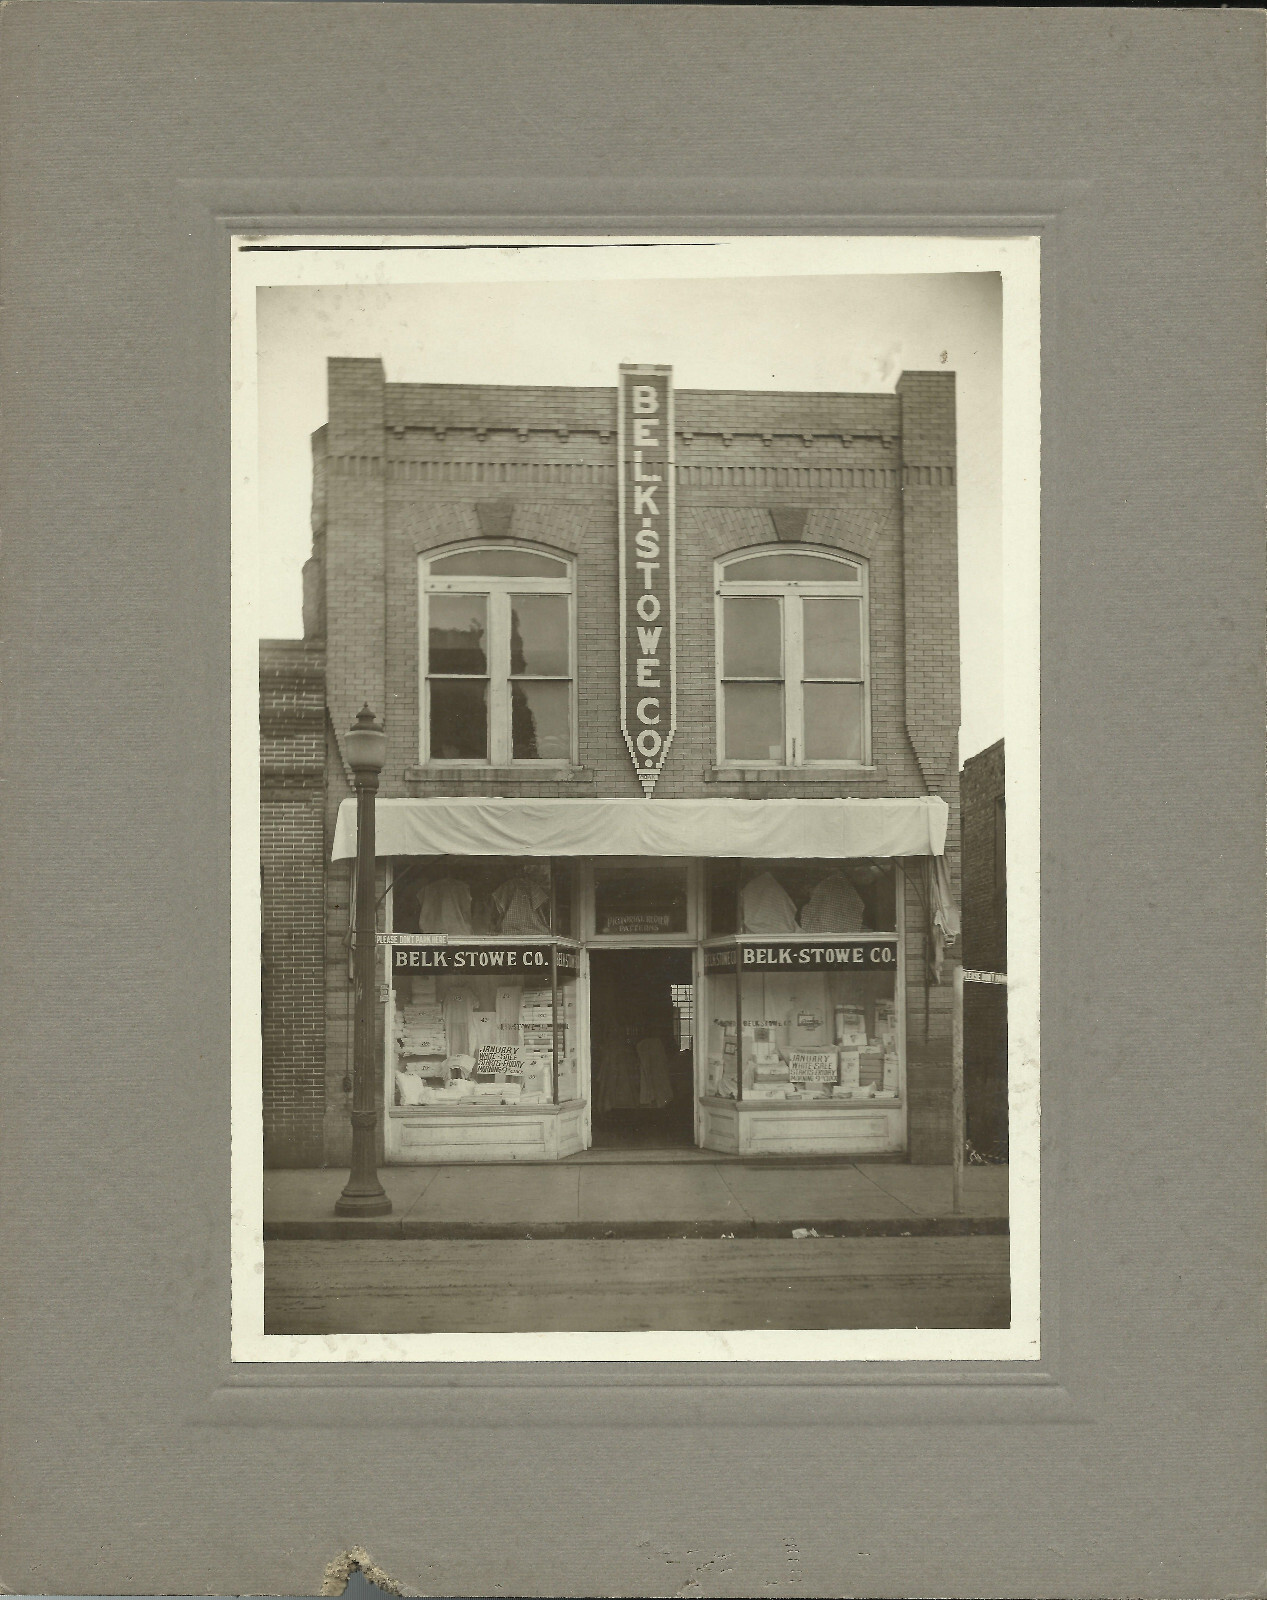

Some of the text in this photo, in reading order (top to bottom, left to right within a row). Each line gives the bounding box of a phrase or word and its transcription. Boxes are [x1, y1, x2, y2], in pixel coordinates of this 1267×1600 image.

[633, 385, 662, 688] BELK-STOWE
[636, 697, 662, 768] CO.
[376, 935, 398, 944] PLEASE
[415, 935, 431, 944] PARK
[431, 935, 447, 944] HERE
[395, 951, 517, 967] BELK-STOWE
[522, 951, 549, 967] CO.
[743, 947, 896, 964] BELK-STOWE CO.
[479, 1045, 519, 1055] JANUARY
[790, 1054, 830, 1063] JANUARY
